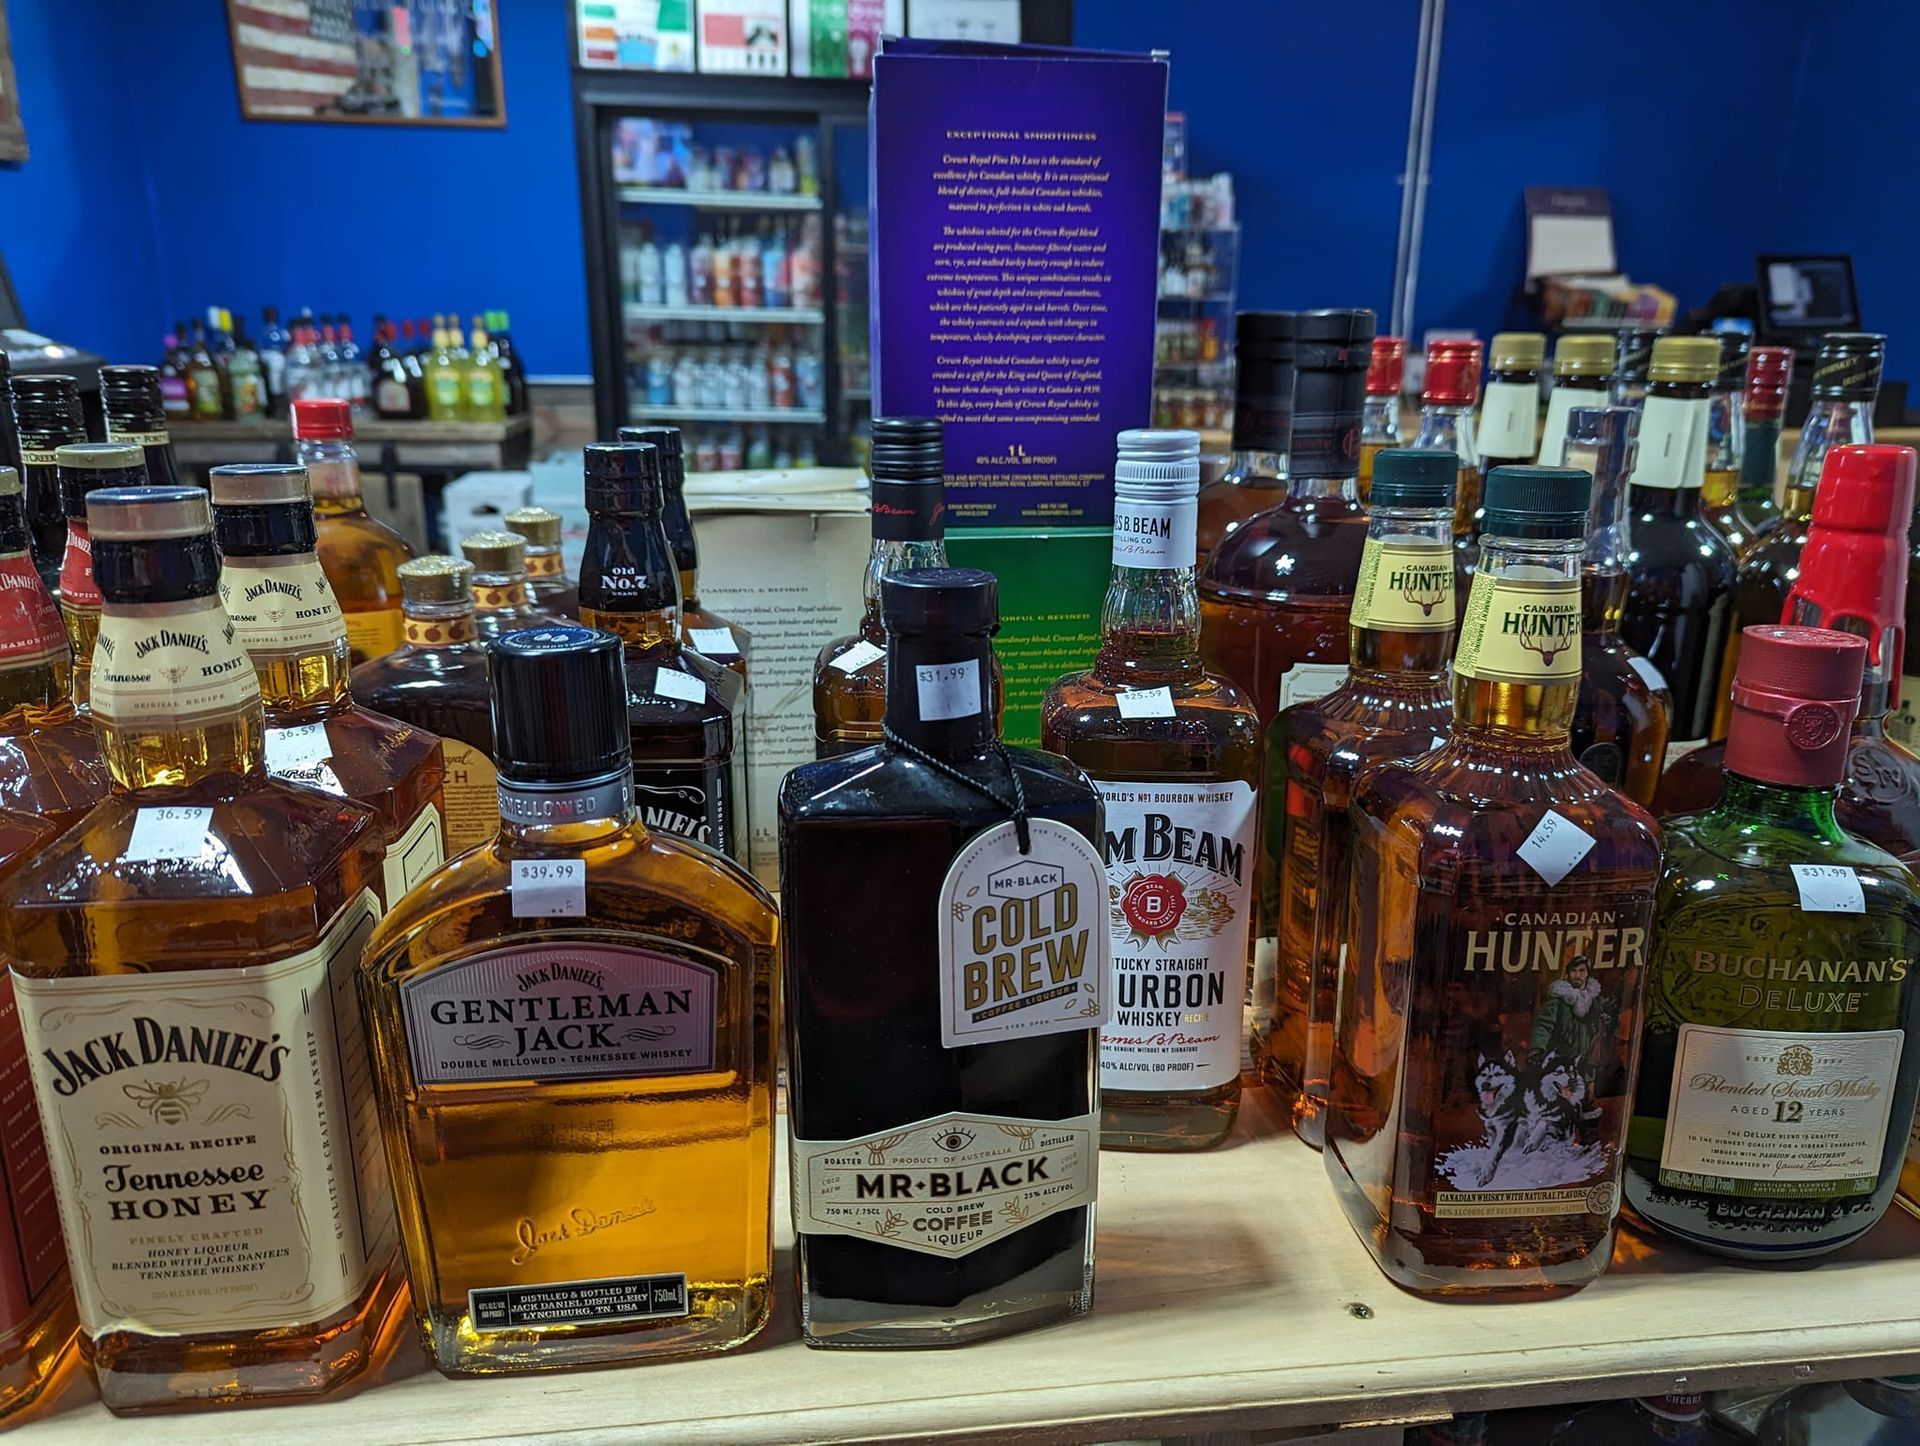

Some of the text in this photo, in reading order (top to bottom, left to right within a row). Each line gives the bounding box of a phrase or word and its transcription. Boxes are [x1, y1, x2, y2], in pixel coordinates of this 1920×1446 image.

[947, 131, 1097, 141] EXCEPTIONAL SMOOTHNESS
[943, 154, 968, 164] Crown
[970, 154, 990, 167] Royal
[992, 155, 1008, 164] Fine
[1049, 157, 1060, 166] the
[1061, 157, 1092, 166] standard
[1093, 157, 1102, 168] of
[1133, 516, 1171, 540] BEAM
[612, 566, 636, 576] Old
[245, 582, 266, 602] JACK
[296, 605, 332, 619] HONEY
[797, 606, 816, 614] Royal
[1523, 604, 1574, 614] CANADIAN
[135, 629, 210, 659] JACK DANIEL'S
[284, 633, 313, 642] RECIPE
[201, 655, 243, 677] HONEY
[134, 692, 226, 710] ORIGINAL RECIPE
[1124, 690, 1162, 700] $25.59
[279, 724, 316, 741] 36.59
[1154, 794, 1194, 803] BOURBON
[1198, 792, 1234, 802] WHISKEY
[156, 808, 202, 821] 36.59
[504, 796, 596, 818] MELLOWED
[1530, 818, 1558, 850] 14.59
[1142, 813, 1246, 887] BEAM
[520, 866, 574, 880] $39.99
[1146, 896, 1162, 913] B
[972, 882, 1078, 956] COLD
[1504, 911, 1617, 926] CANADIAN
[1464, 927, 1646, 974] HUNTER
[964, 928, 1090, 1012] BREW
[1112, 957, 1209, 972] TUCKY STRAIGHT
[1694, 950, 1908, 984] BUCHANAN'S
[516, 962, 605, 992] JACK DANIEL'S
[1118, 971, 1224, 1008] URBON
[430, 988, 692, 1026] GENTLEMAN
[981, 986, 1071, 1020] COFFEE LIQUEUR
[1029, 1019, 1050, 1028] OPEN
[1117, 1010, 1182, 1027] WHISKEY
[514, 1022, 617, 1058] JACK
[42, 1017, 291, 1098] JACK DANIEL'S
[441, 1048, 693, 1070] DOUBLE MELLOWED TENNESSEE WHISKEY
[1101, 1061, 1118, 1070] 40%
[1120, 1062, 1150, 1072] ALC/VOL
[1689, 1073, 1880, 1101] Blended Scotch Whisky
[1731, 1100, 1845, 1124] AGED 12 YEARS
[306, 1030, 344, 1240] QUALITY CRAFTSMANSHIP
[1040, 1134, 1075, 1148] DISTILLER
[1715, 1138, 1745, 1147] HIGHEST
[1744, 1130, 1776, 1140] DELUXE
[100, 1134, 257, 1156] ORIGINAL RECIPE
[961, 1148, 1012, 1162] AUSTRALIA
[1717, 1160, 1761, 1168] GUARANTEED
[103, 1162, 265, 1194] Tennessee
[1024, 1184, 1074, 1200] 25% ALC/VOL
[1440, 1188, 1588, 1202] CANADIAN WHISKY WITH NATURAL FLAVORS
[108, 1188, 272, 1222] HONEY
[926, 1201, 986, 1214] COLD BREW
[1716, 1203, 1825, 1220] BUCHANAN
[912, 1210, 994, 1232] COFFEE
[130, 1226, 264, 1246] FINELY CRAFTED
[927, 1230, 984, 1246] LIQUEUR
[148, 1242, 250, 1258] HONEY LIQUEUR
[112, 1248, 290, 1272] BLENDED WITH JACK DANIEL'S
[140, 1262, 266, 1280] TENNESSEE WHISKEY
[510, 1302, 540, 1312] JACK
[540, 1299, 584, 1310] DANIEL
[584, 1294, 648, 1306] DISTILLERY
[520, 1286, 638, 1304] DISTILLED BOTTLED BY
[522, 1304, 638, 1320] LYNCHBURG, TN. USA
